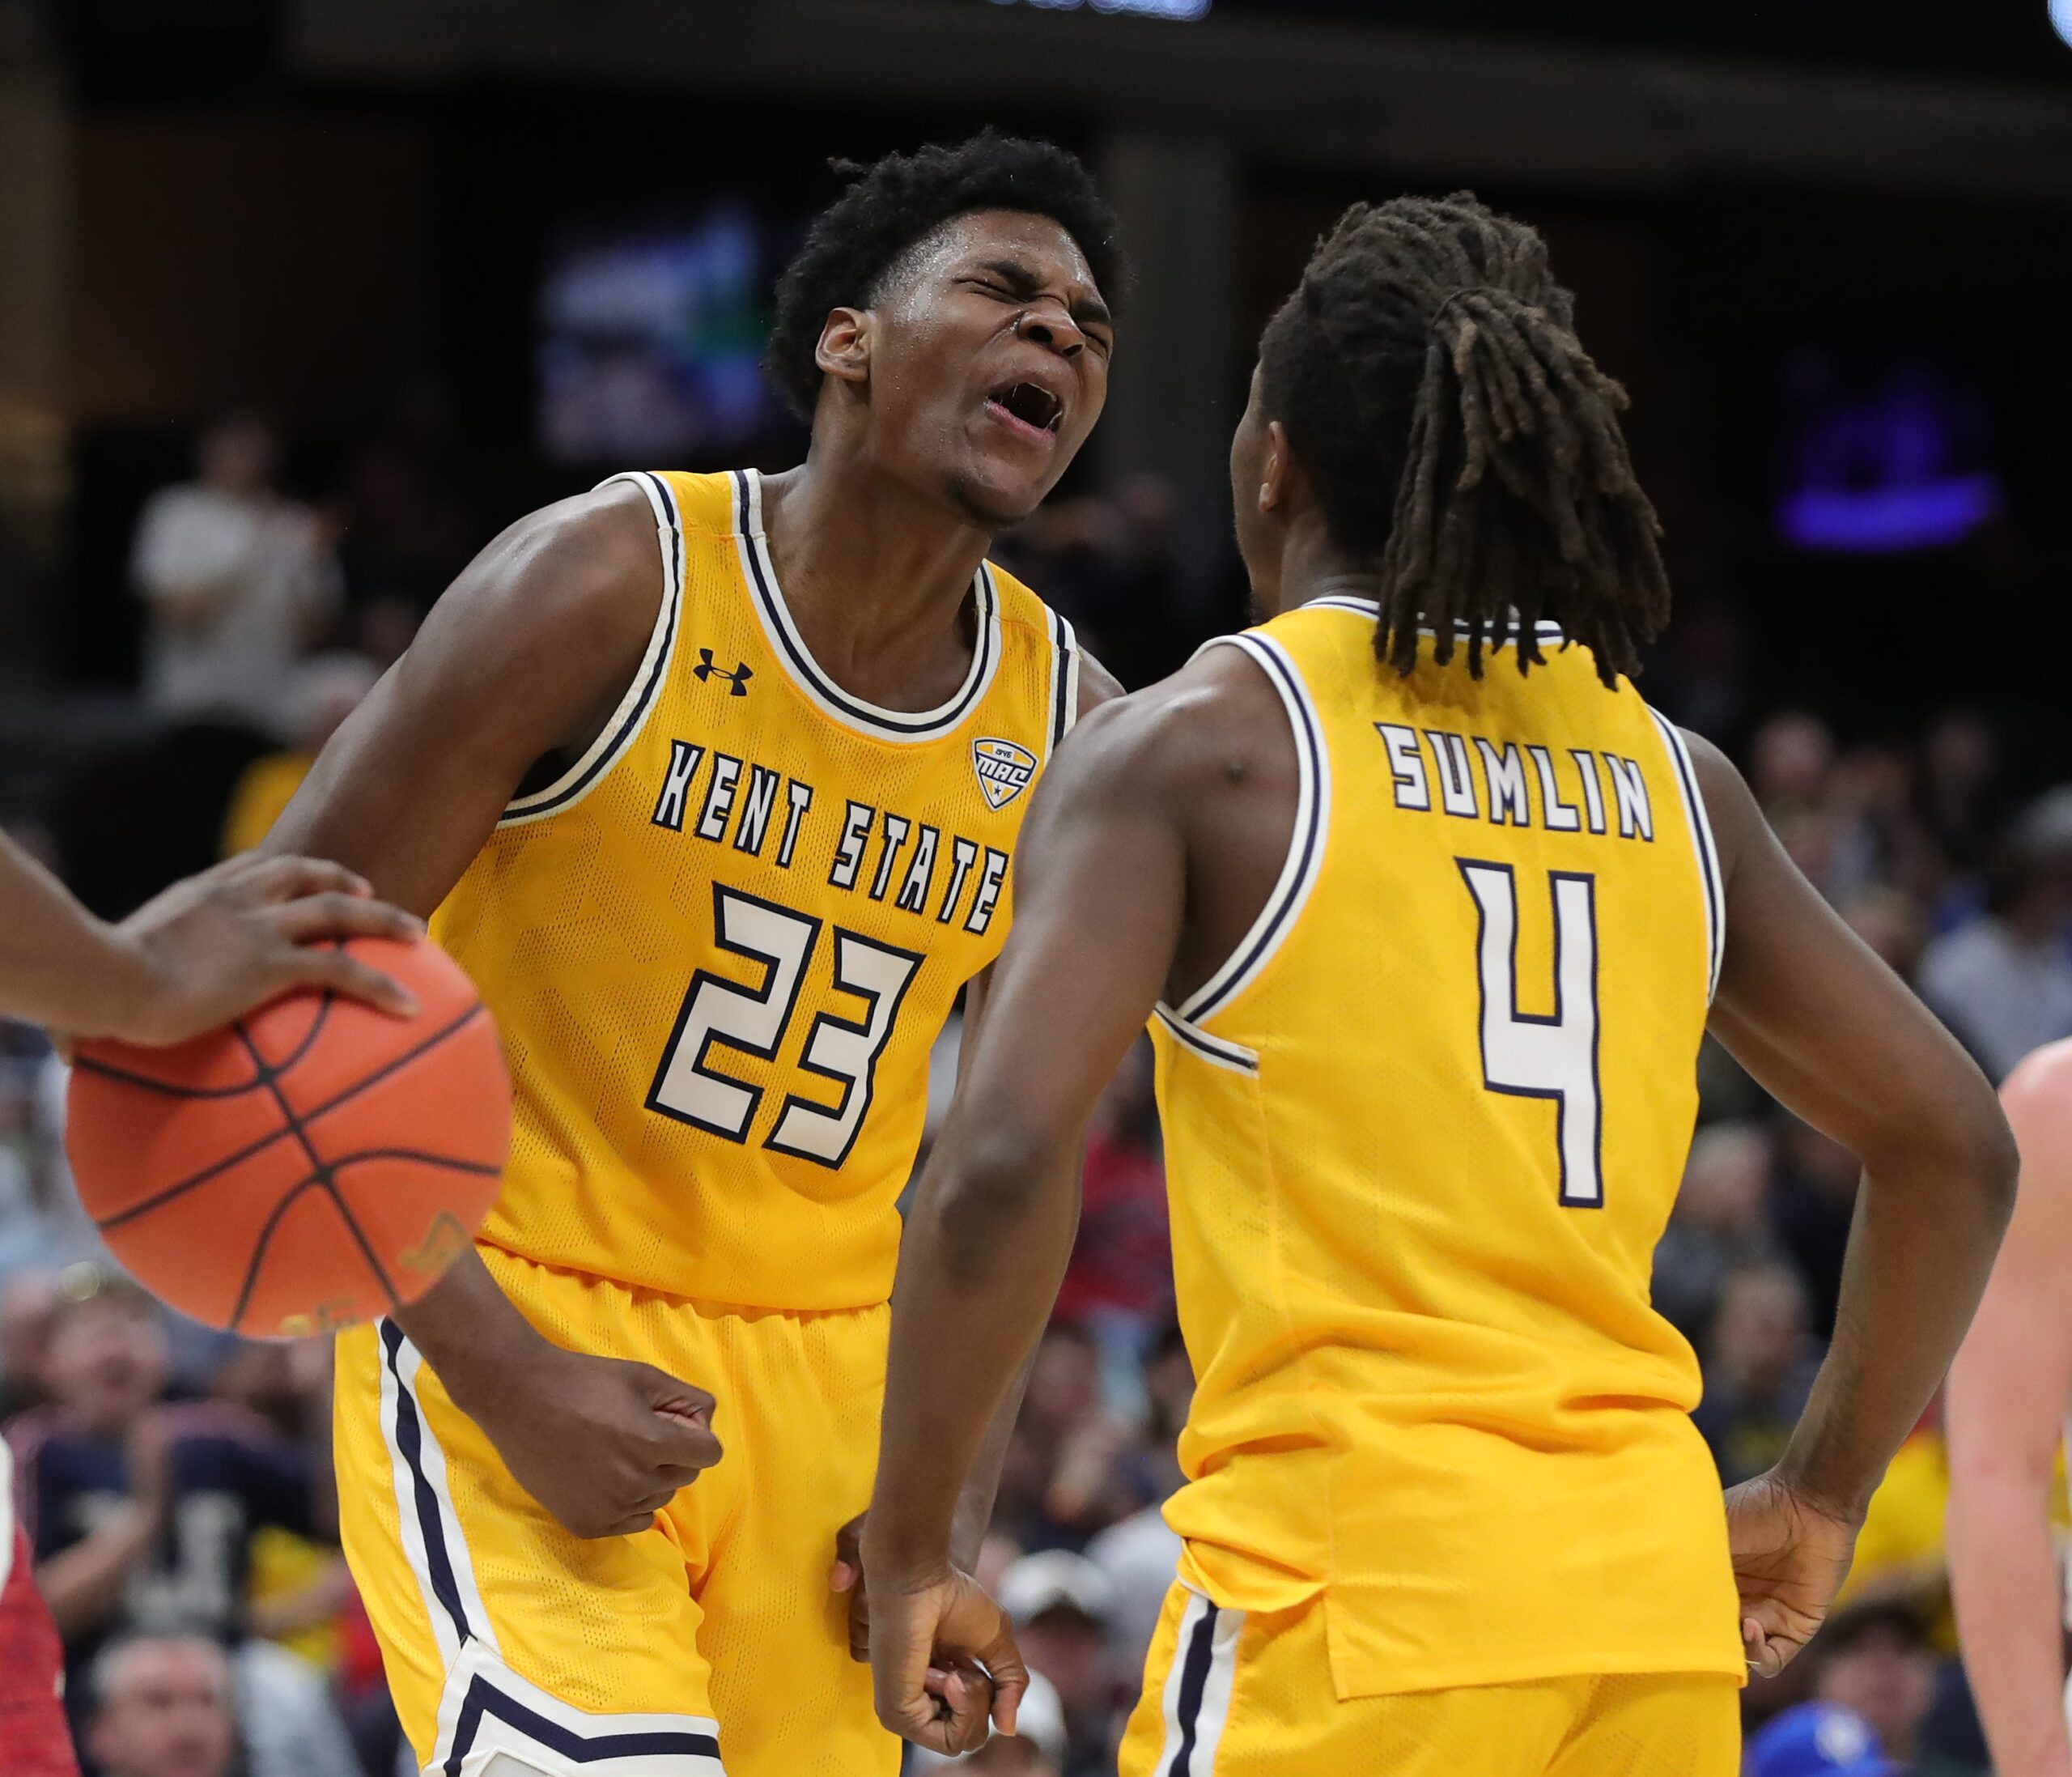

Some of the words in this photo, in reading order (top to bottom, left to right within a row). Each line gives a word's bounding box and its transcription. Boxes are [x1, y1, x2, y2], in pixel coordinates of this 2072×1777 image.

[652, 739, 813, 868] KENT
[828, 799, 1008, 936] STATE
[977, 755, 1029, 785] MAC
[1373, 722, 1654, 842] SUMLIN
[644, 881, 927, 1171] 23
[1453, 856, 1603, 1208] 4
